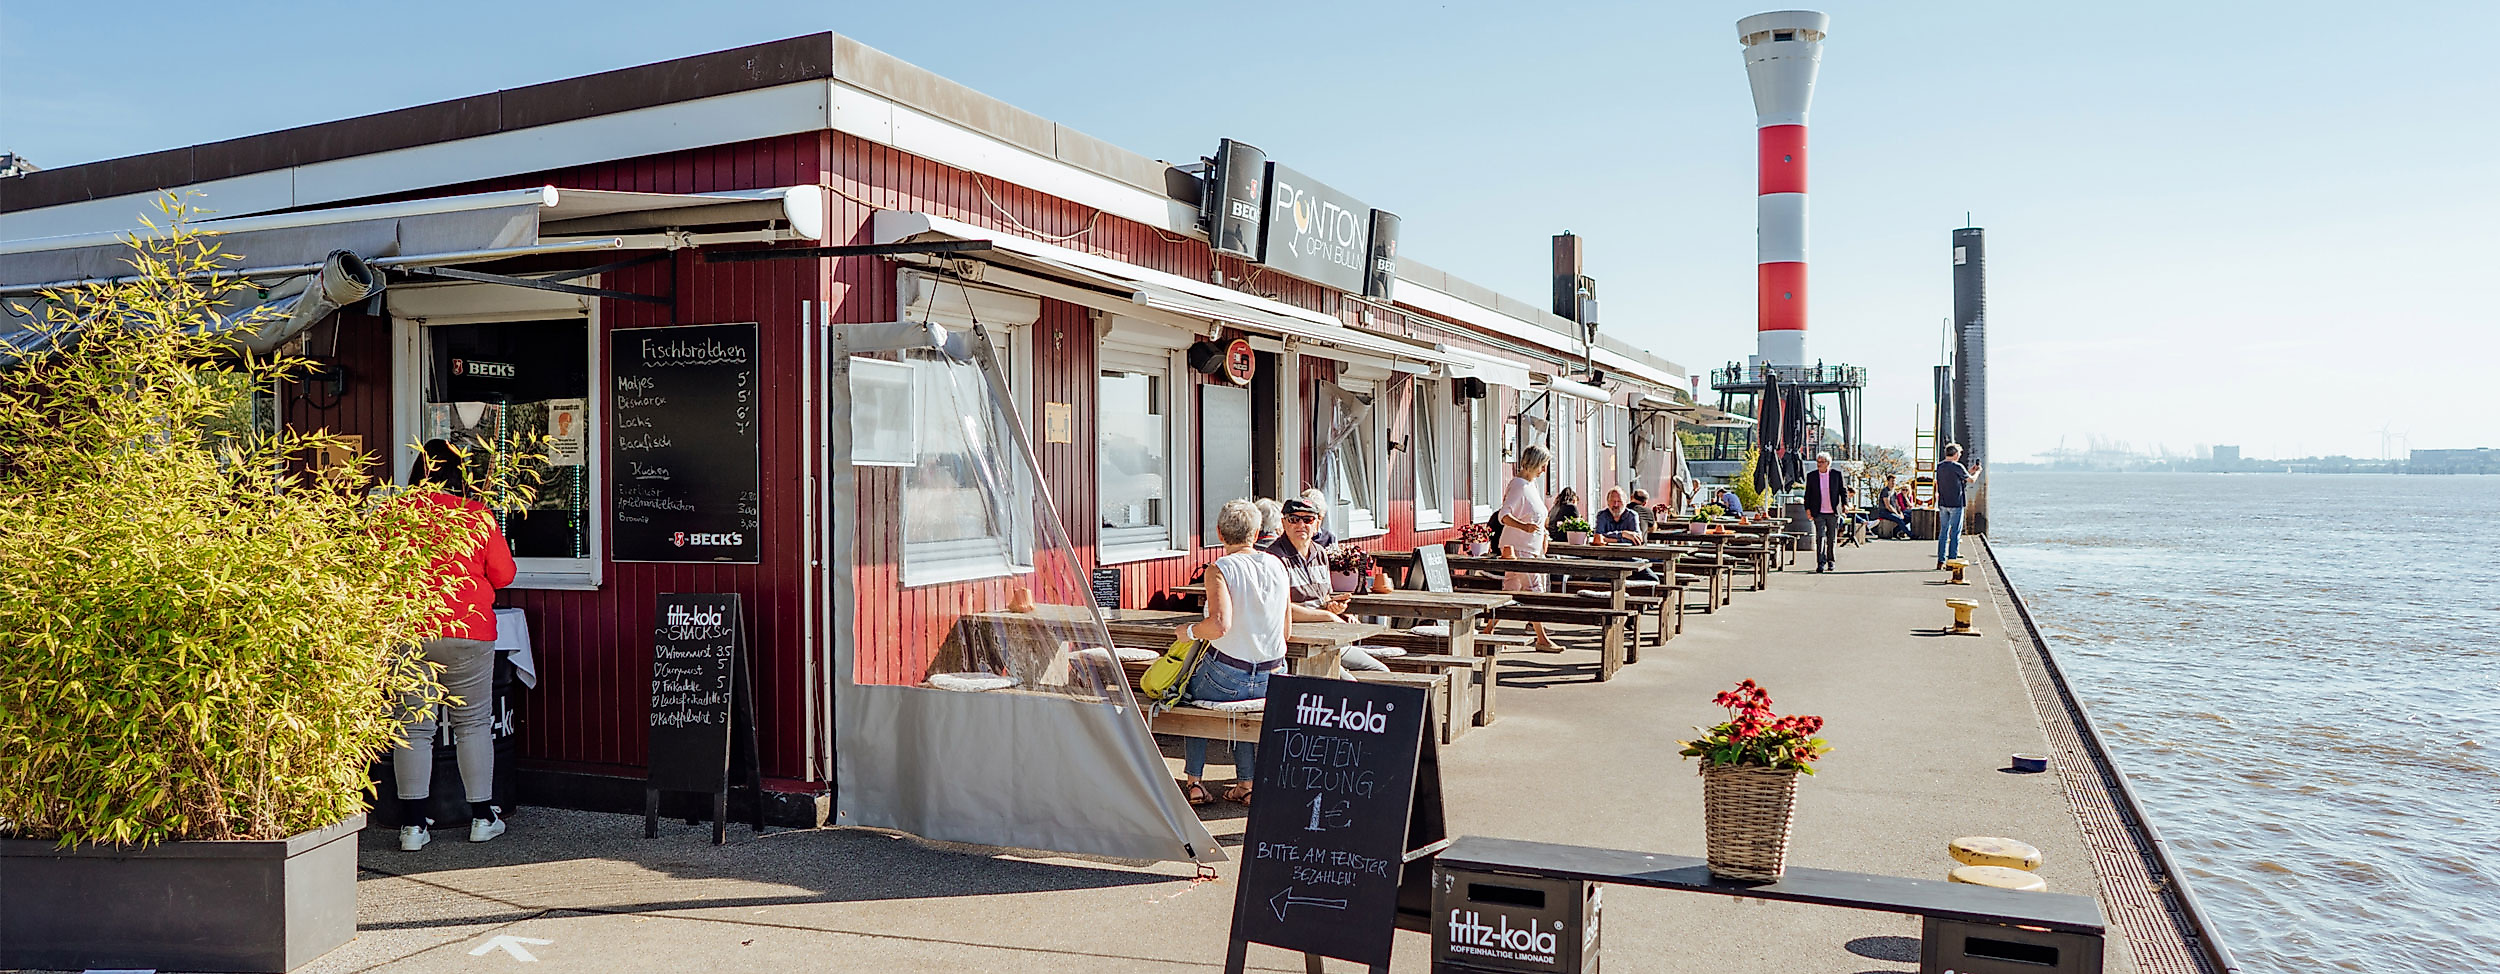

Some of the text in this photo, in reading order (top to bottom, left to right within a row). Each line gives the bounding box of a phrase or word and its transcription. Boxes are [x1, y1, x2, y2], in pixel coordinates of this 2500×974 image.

[1275, 181, 1367, 255] PONTON
[1305, 236, 1332, 261] OP'N
[642, 336, 746, 360] Fischbrötchen
[468, 362, 516, 377] BECK'S
[617, 375, 655, 397] Matjes
[618, 412, 653, 429] Lachs
[619, 433, 672, 452] Backfisch
[630, 461, 670, 476] Kuchen
[690, 532, 743, 546] BECK'S
[717, 658, 728, 670] 5
[716, 675, 726, 689] 5
[722, 692, 731, 704] 5
[719, 711, 728, 724] 5
[1256, 841, 1388, 878] BITTE AM FENSTER
[1292, 865, 1357, 887] BEZAHLEN!
[1450, 944, 1555, 965] KOFFEINHALTIGE LIMONADE
